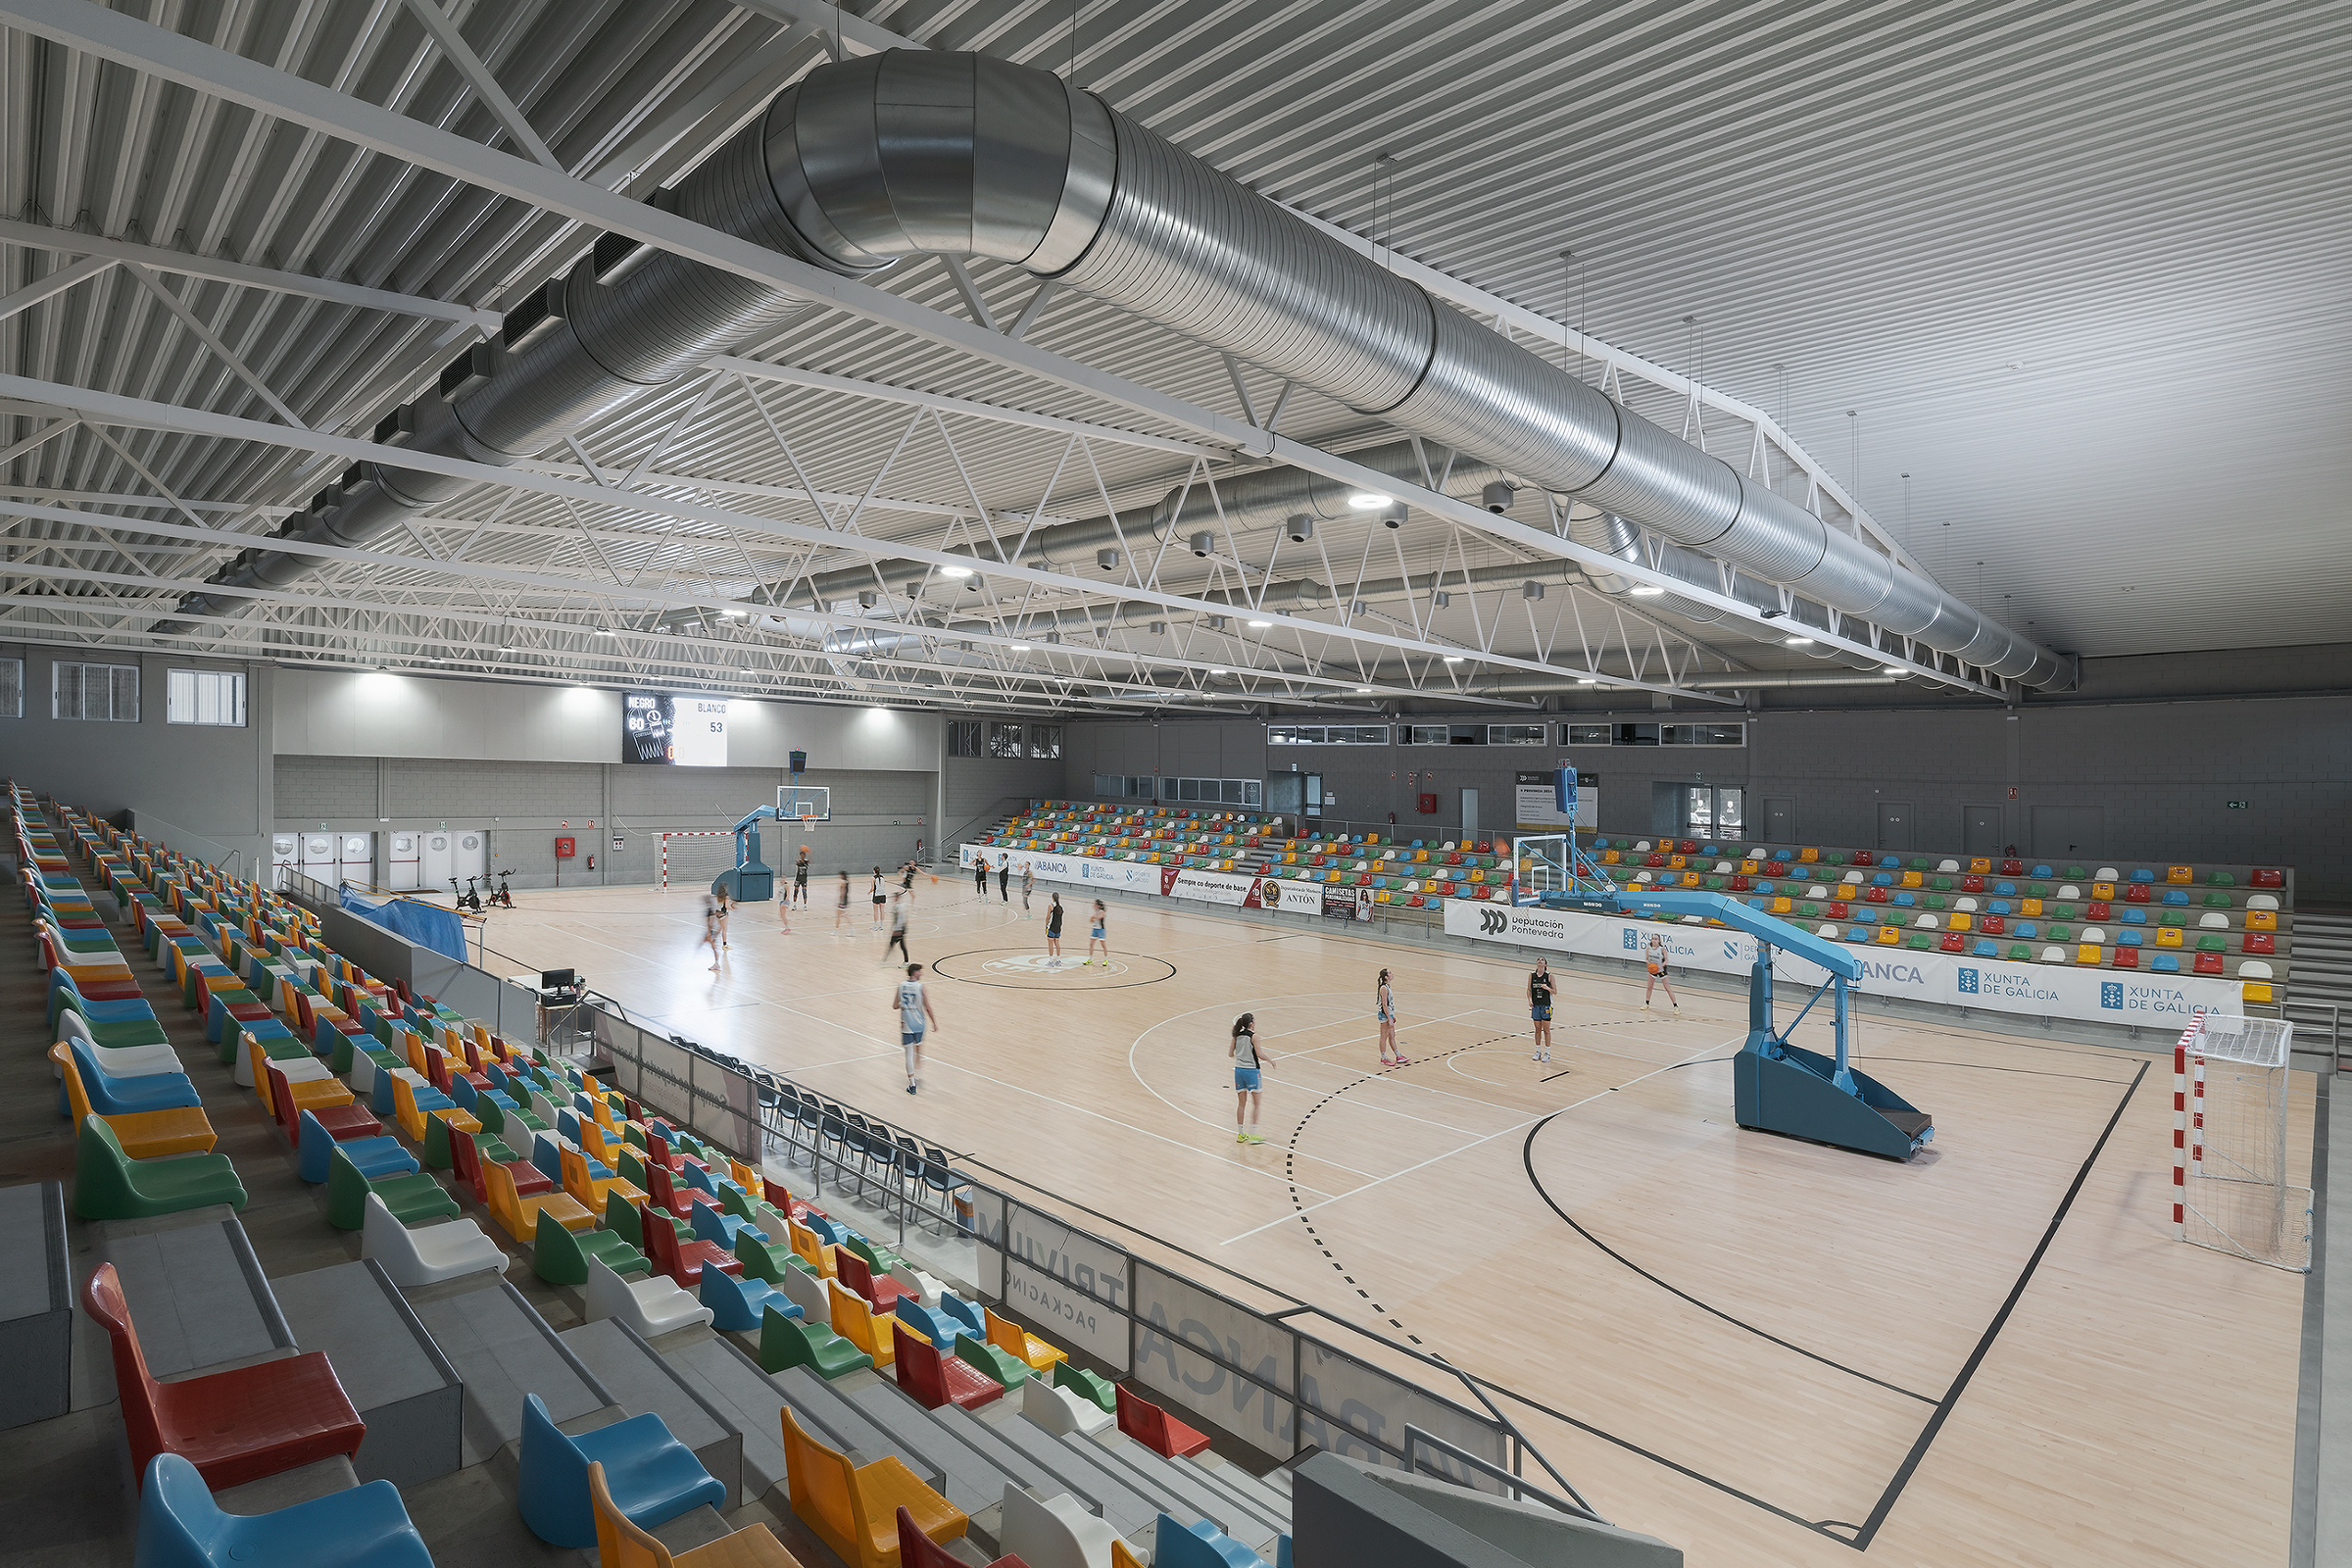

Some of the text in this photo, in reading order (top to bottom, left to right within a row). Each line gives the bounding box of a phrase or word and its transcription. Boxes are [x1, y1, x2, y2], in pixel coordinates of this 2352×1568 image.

[628, 696, 656, 709] NEGRO
[698, 703, 726, 713] BLANCO
[710, 722, 723, 733] 53
[1177, 877, 1196, 886] Sempre
[1204, 880, 1225, 889] deporte
[1233, 884, 1248, 893] base.
[1325, 886, 1354, 897] CAMISETAS
[1286, 894, 1315, 905] ANTÓN
[1512, 915, 1564, 929] Deputación
[1511, 924, 1564, 939] Pontevedra
[1641, 932, 1673, 943] XUTA
[1664, 945, 1694, 956] ALICIA
[1984, 972, 2031, 987] XUNTA
[1984, 984, 2059, 1001] DE GALICIA
[2129, 986, 2184, 1001] XUNTA
[2129, 999, 2147, 1009] DE
